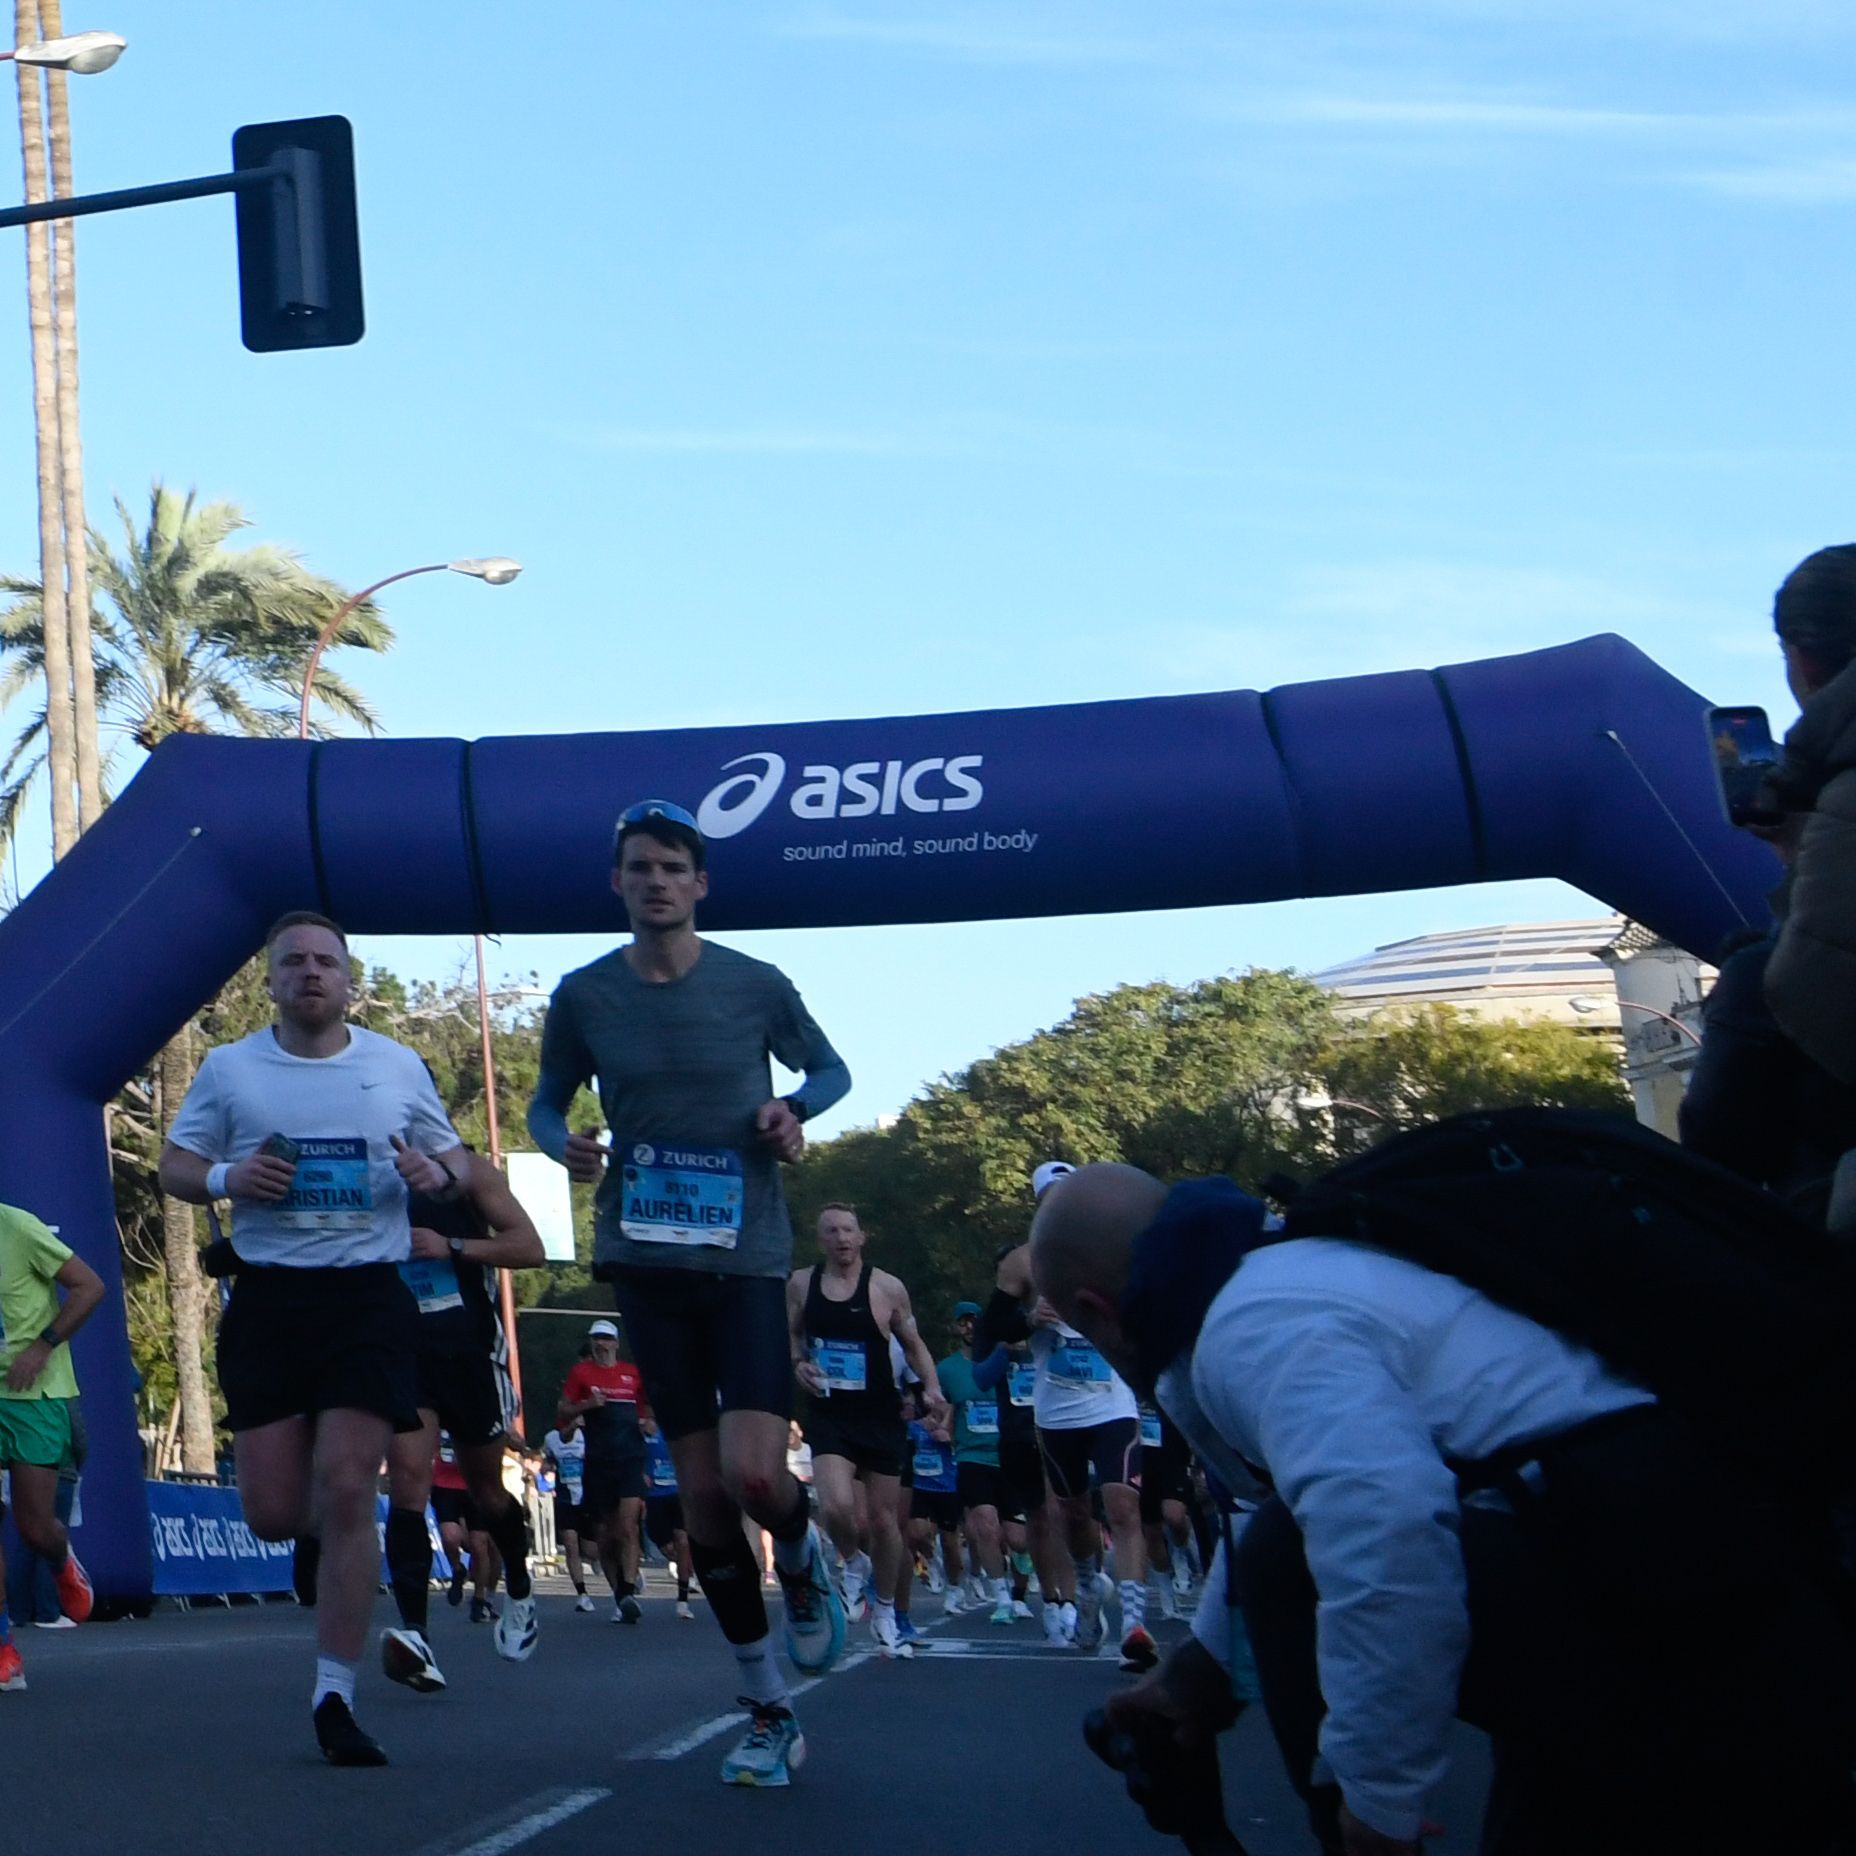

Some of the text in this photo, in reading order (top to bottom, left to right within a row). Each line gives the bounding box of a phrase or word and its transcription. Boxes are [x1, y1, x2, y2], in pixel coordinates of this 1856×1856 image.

[782, 828, 1039, 862] sound mind, sound body
[300, 1143, 356, 1156] ZURICH
[662, 1150, 729, 1169] ZURICH
